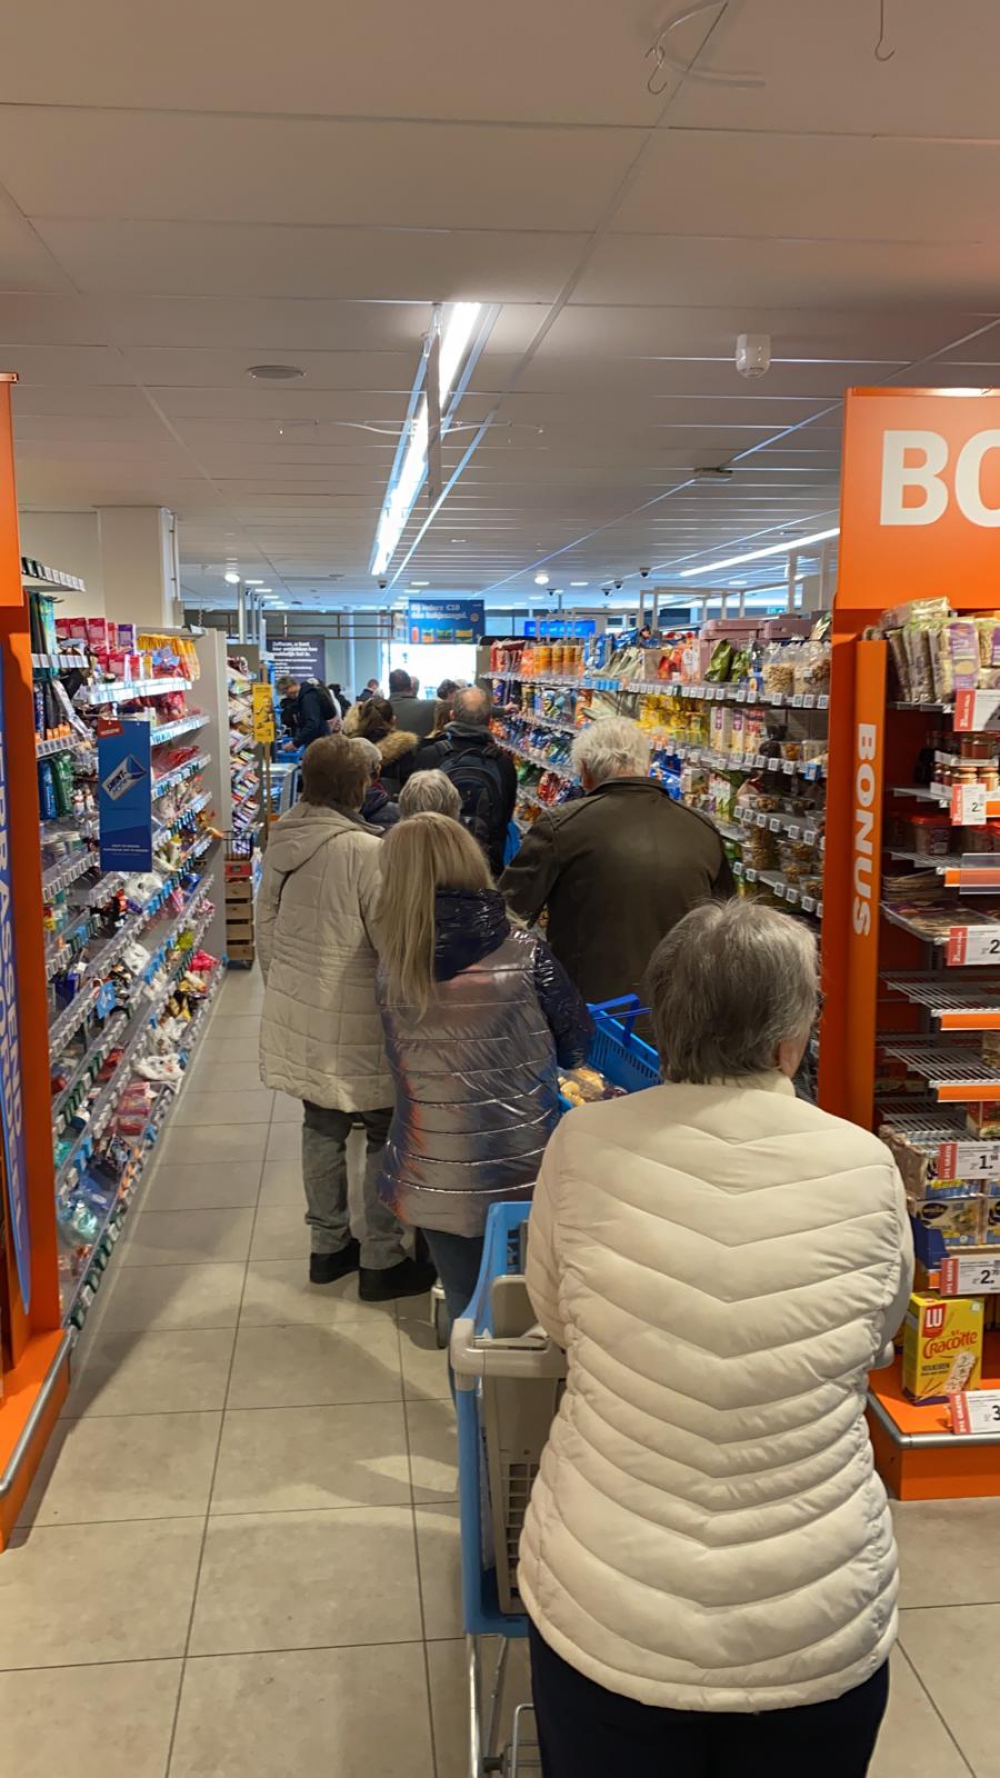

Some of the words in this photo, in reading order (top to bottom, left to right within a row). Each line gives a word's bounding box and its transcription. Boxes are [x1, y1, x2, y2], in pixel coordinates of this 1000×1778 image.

[880, 429, 1000, 528] BO
[852, 723, 877, 937] BONUS
[926, 1308, 942, 1328] LU
